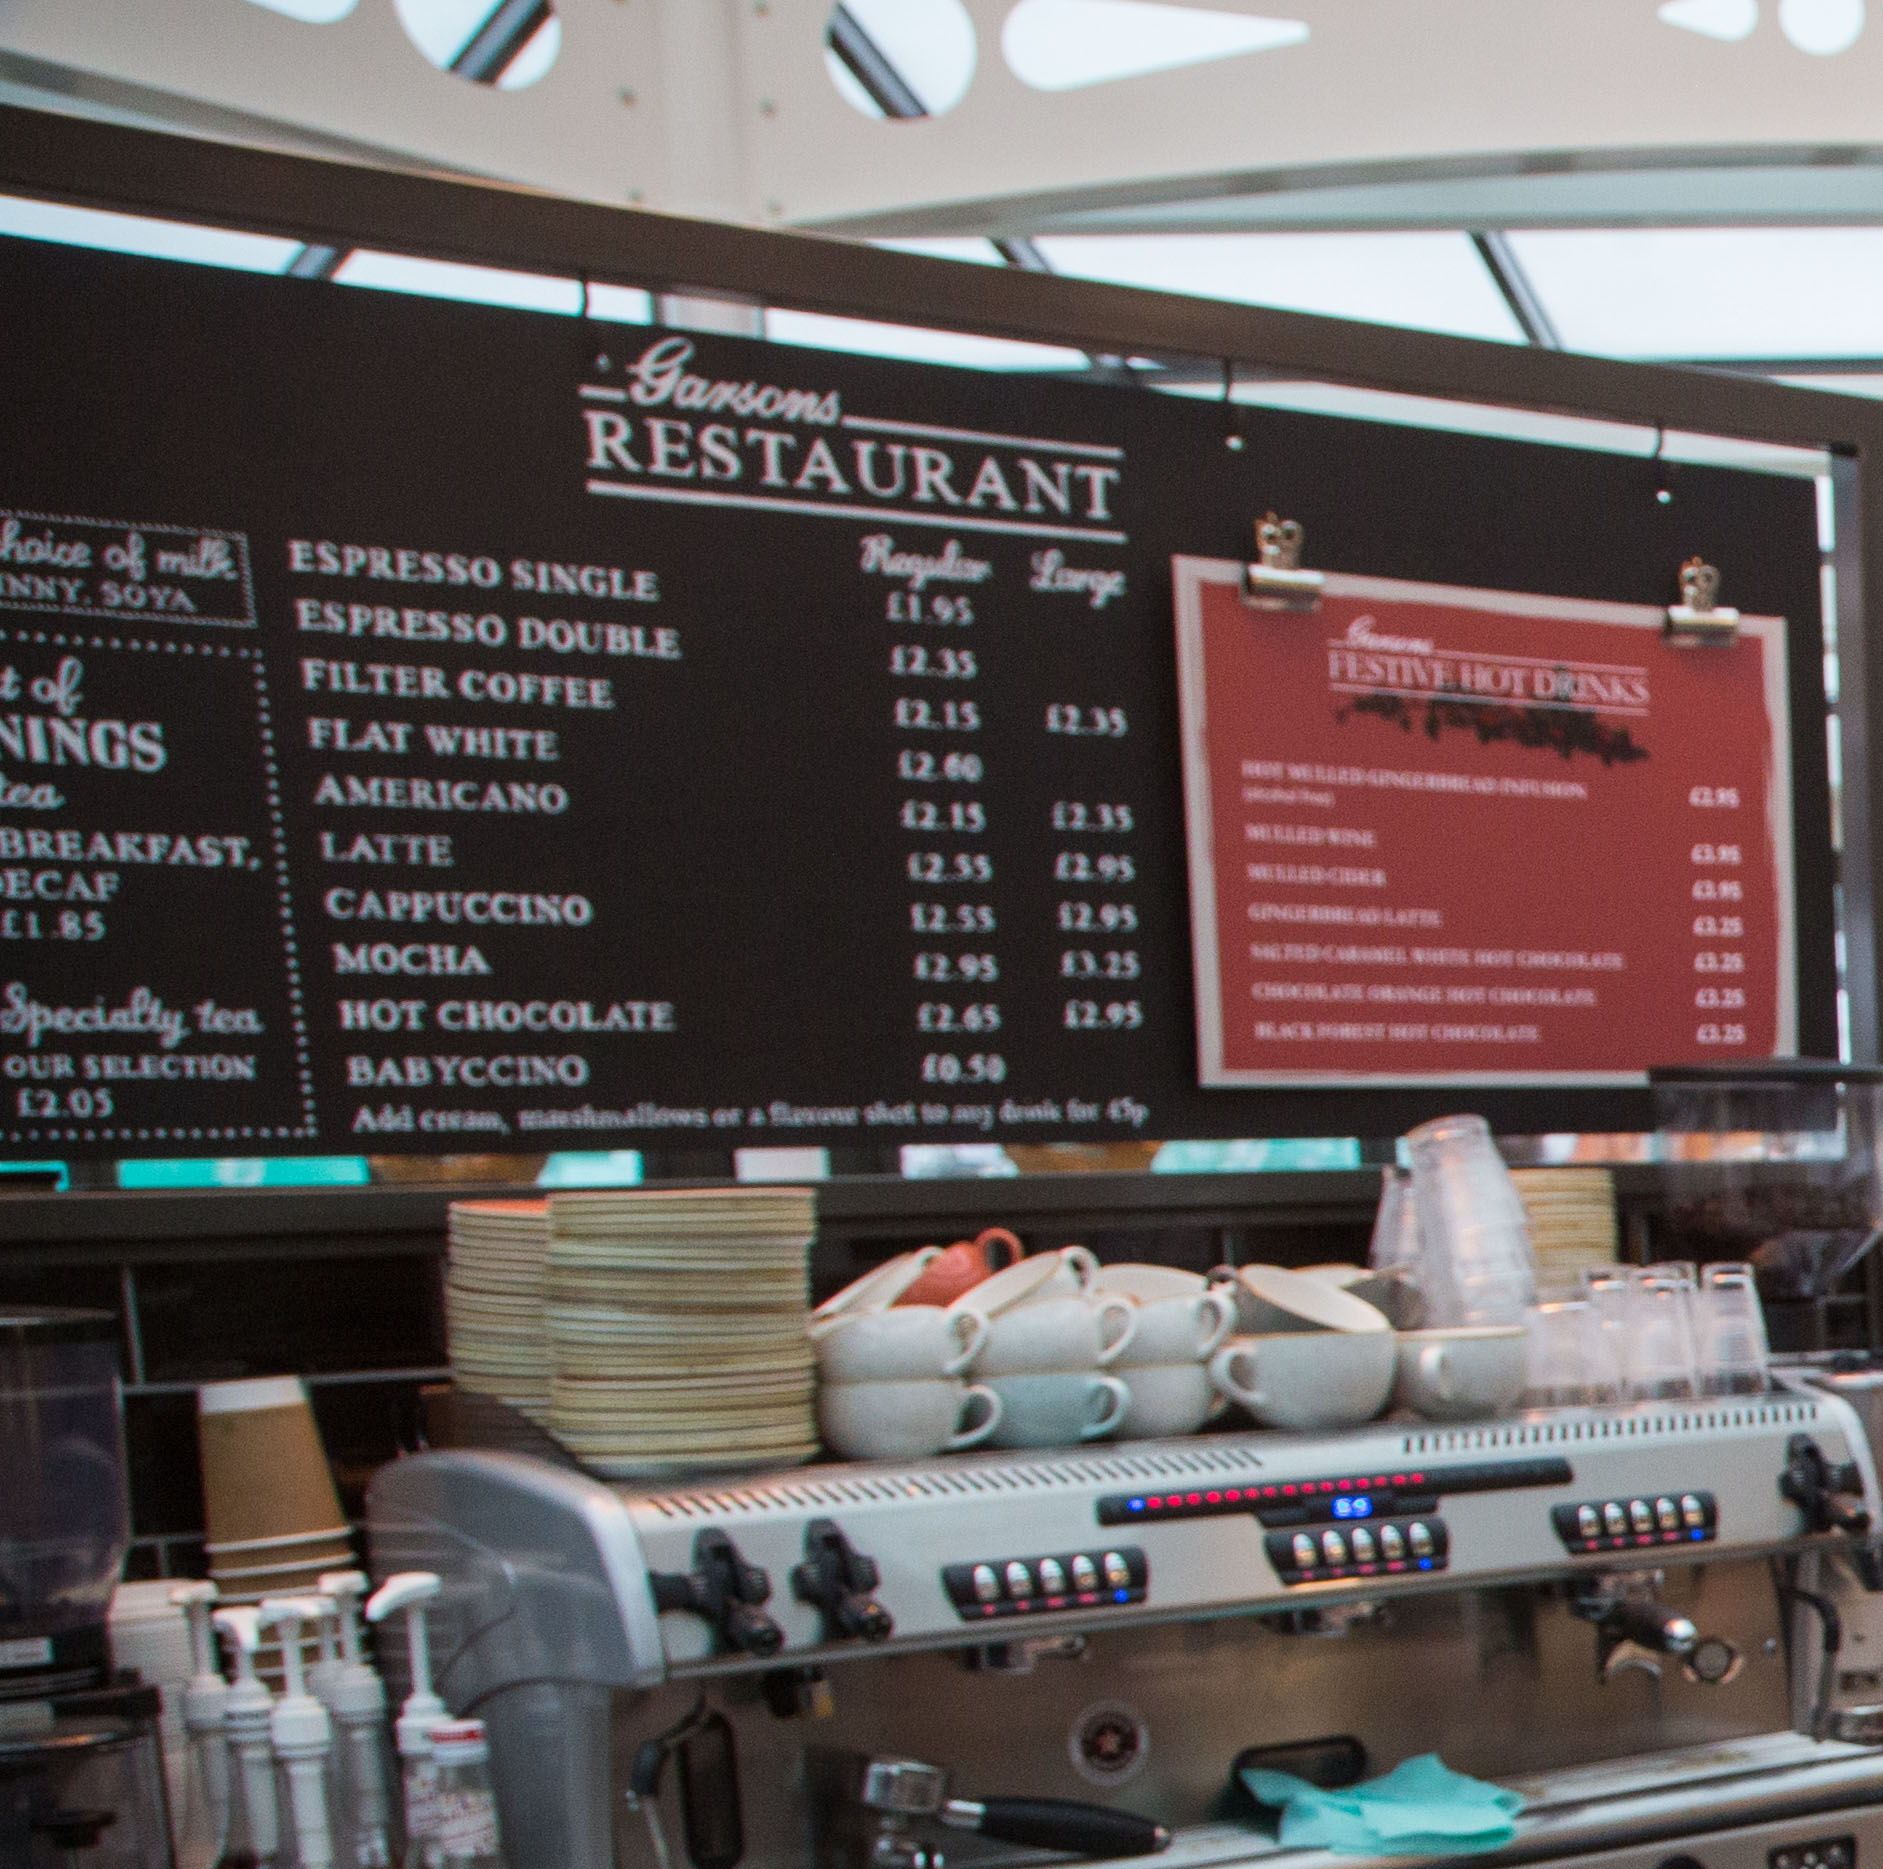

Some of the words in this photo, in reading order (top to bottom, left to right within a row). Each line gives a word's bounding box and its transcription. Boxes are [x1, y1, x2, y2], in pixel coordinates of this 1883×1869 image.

[627, 336, 841, 427] Garsons
[582, 407, 1120, 520] RESTAURANT
[103, 530, 147, 581] of
[157, 536, 238, 581] milk
[288, 539, 502, 588] ESPRESSO
[510, 558, 660, 602] SINGLE
[859, 533, 993, 592] Regular
[1029, 548, 1127, 610] Large
[100, 579, 198, 612] SOYA
[886, 590, 975, 627] £1.95
[295, 598, 507, 647] ESPRESSO
[517, 616, 682, 660] DOUBLE
[889, 644, 978, 680] £2.35
[1328, 650, 1452, 691] FESTIVE
[1460, 662, 1530, 697] HOT
[1533, 668, 1650, 704] DRINKS
[29, 655, 84, 716] of
[301, 658, 452, 698] FILTER
[457, 670, 616, 710] COFFEE
[894, 697, 981, 732] £2.15
[1045, 702, 1129, 738] £2.35
[307, 717, 413, 753] FLAT
[424, 724, 560, 761] WHITE
[313, 773, 570, 815] AMERICANO
[900, 799, 987, 833] £2.15
[1050, 800, 1135, 833] £2.35
[320, 831, 455, 867] LATTE
[0, 868, 120, 901] ECAF
[906, 852, 994, 883] £2.55
[1054, 851, 1136, 884] £2.95
[1, 909, 107, 940] £1.85
[324, 887, 594, 926] CAPPUCCINO
[909, 902, 997, 934] £2.55
[1056, 901, 1139, 933] £2.95
[332, 943, 494, 975] MOCHA
[912, 952, 999, 983] £2.95
[0, 981, 191, 1049] Specialty
[192, 998, 265, 1034] tea
[338, 999, 427, 1031] HOT
[436, 1001, 677, 1032] CHOCOLATE
[1063, 999, 1145, 1030] £2.95
[3, 1055, 75, 1079] OUR
[82, 1055, 256, 1080] SELECTION
[346, 1054, 590, 1087] BABYCCINO
[16, 1087, 116, 1118] £2.05
[352, 1104, 415, 1132] Add
[518, 1102, 710, 1130] marshmallows
[713, 1107, 743, 1127] or
[747, 1106, 766, 1127] a
[864, 1100, 917, 1126] shot
[921, 1102, 950, 1124] to
[952, 1104, 994, 1131] any
[1000, 1100, 1063, 1123] drink
[1067, 1099, 1100, 1121] for
